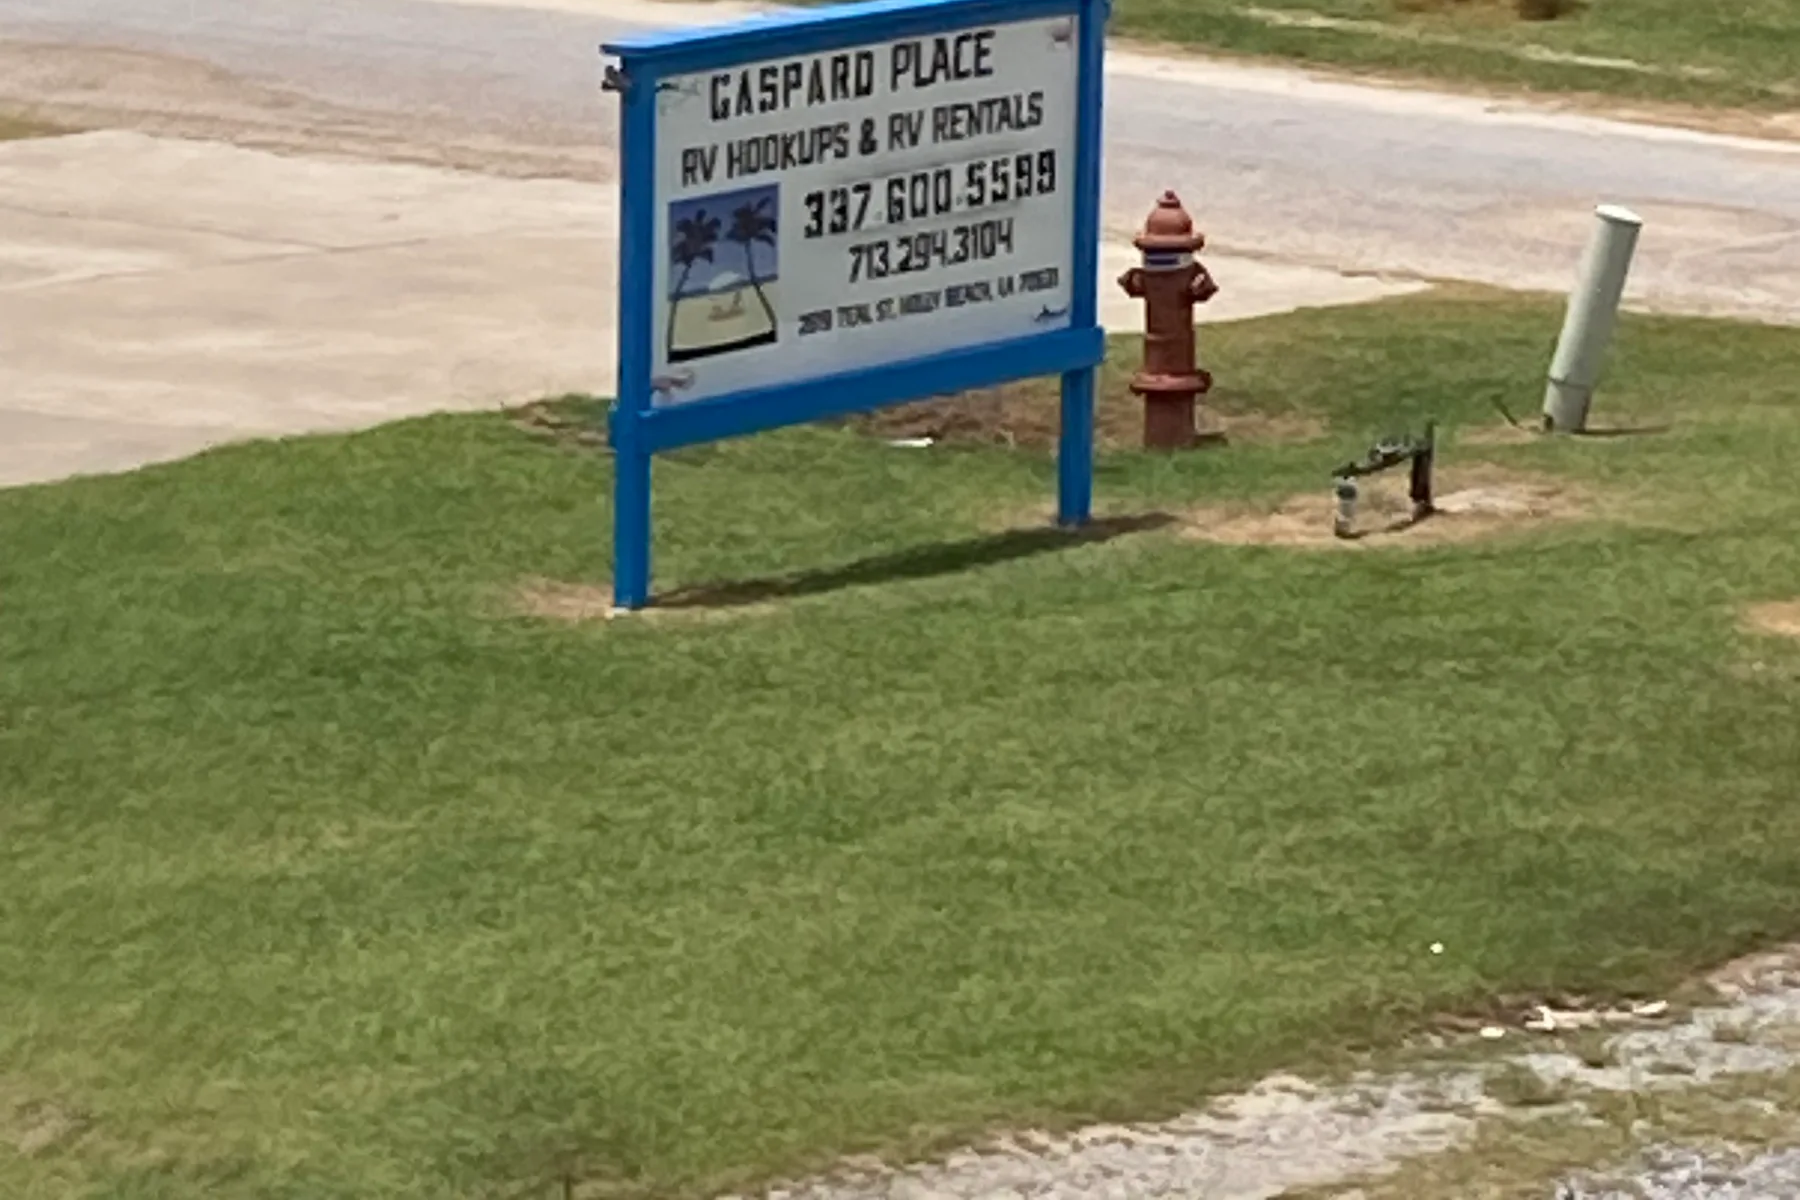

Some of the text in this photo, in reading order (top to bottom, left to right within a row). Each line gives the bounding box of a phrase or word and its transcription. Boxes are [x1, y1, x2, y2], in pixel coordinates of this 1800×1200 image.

[709, 30, 996, 122] GASPARD PLACE
[681, 90, 1044, 188] RV HOOKUPS & RV RENTALS
[803, 149, 1056, 240] 337.600.5599
[848, 216, 1014, 283] 713.294.3104
